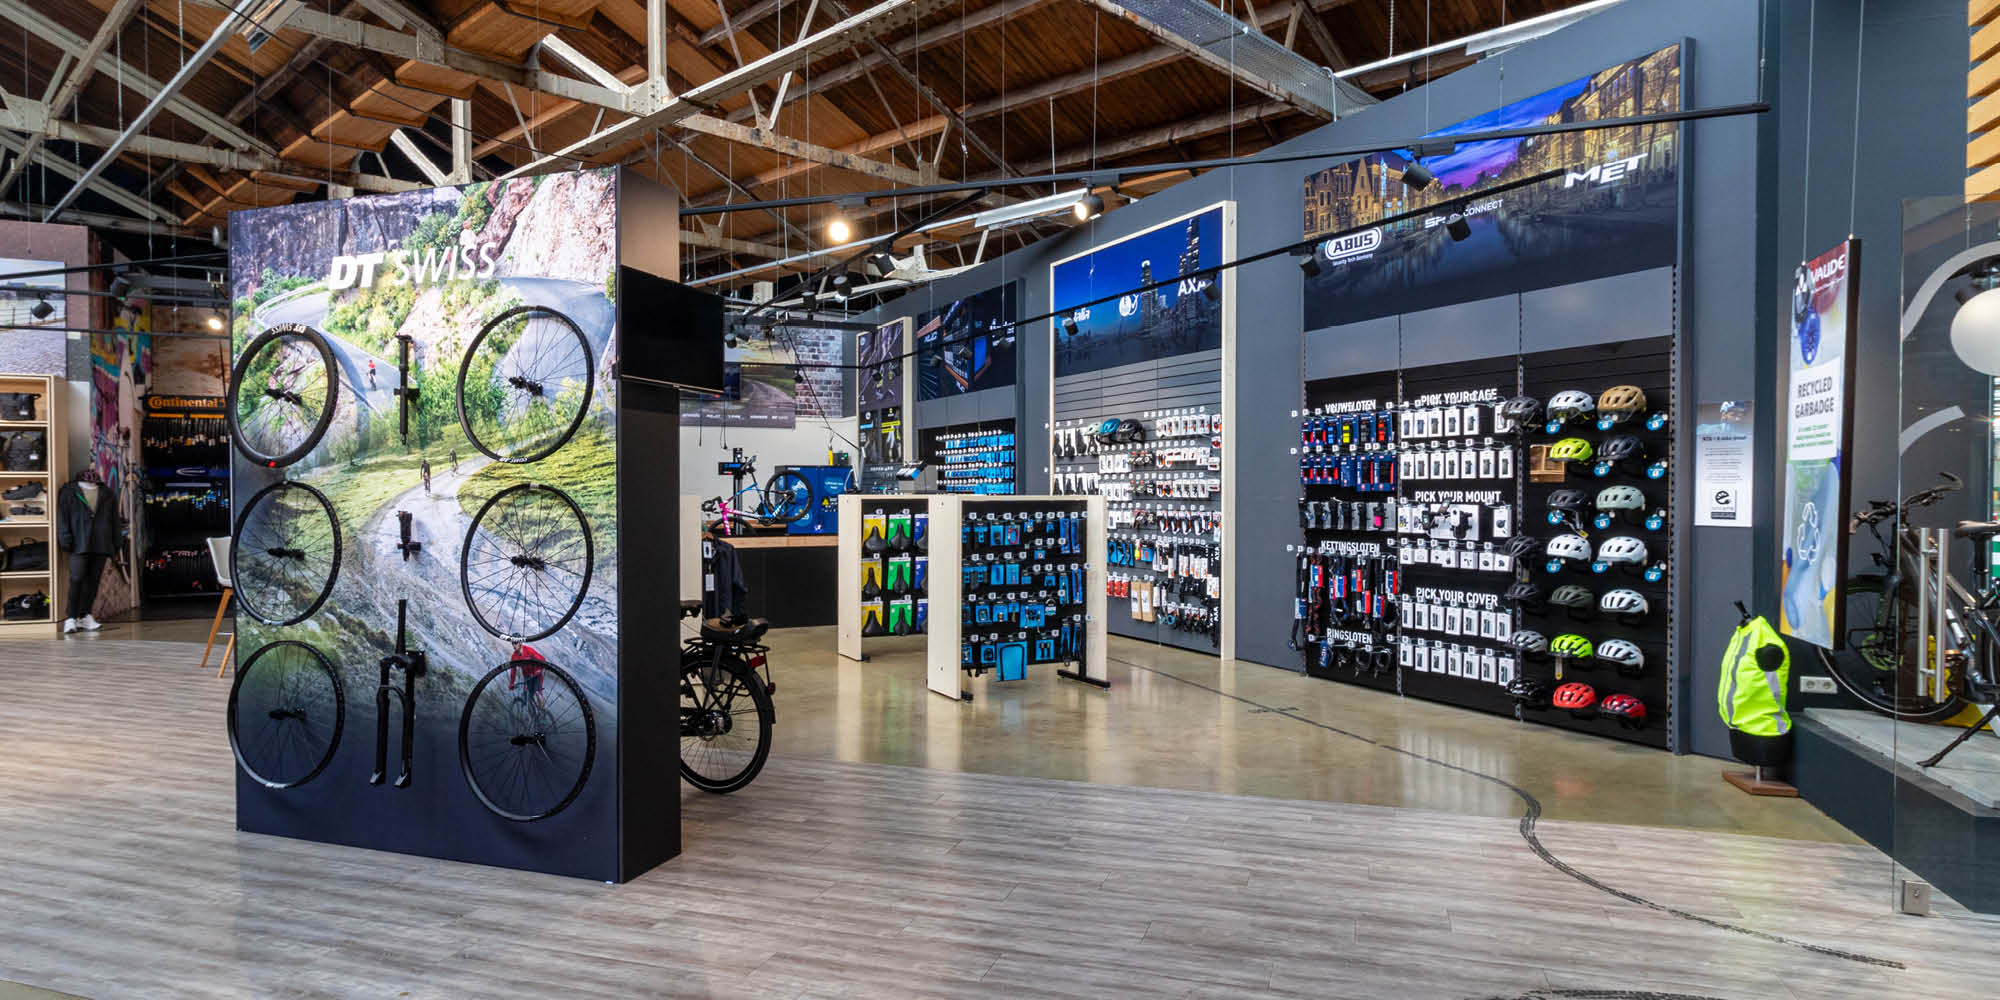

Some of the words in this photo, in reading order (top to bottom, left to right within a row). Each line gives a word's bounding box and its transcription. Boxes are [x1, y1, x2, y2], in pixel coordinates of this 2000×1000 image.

[1564, 152, 1649, 188] MET
[1463, 199, 1504, 217] CONNECT
[1333, 233, 1373, 253] ABUS
[328, 253, 384, 291] DT
[391, 242, 497, 287] SWISS
[1798, 376, 1833, 398] RECYCLED
[149, 396, 218, 408] Continental
[1795, 397, 1835, 419] GARBADGE
[1415, 491, 1435, 503] PICK
[1438, 491, 1462, 503] YOUR
[1465, 491, 1502, 504] MOUNT
[1320, 540, 1380, 556] KETTINGSLOTEN
[1416, 587, 1437, 600] PICK
[1438, 590, 1465, 604] YOUR
[1466, 593, 1499, 607] COVER
[1326, 628, 1373, 645] RINGSLOTEN
